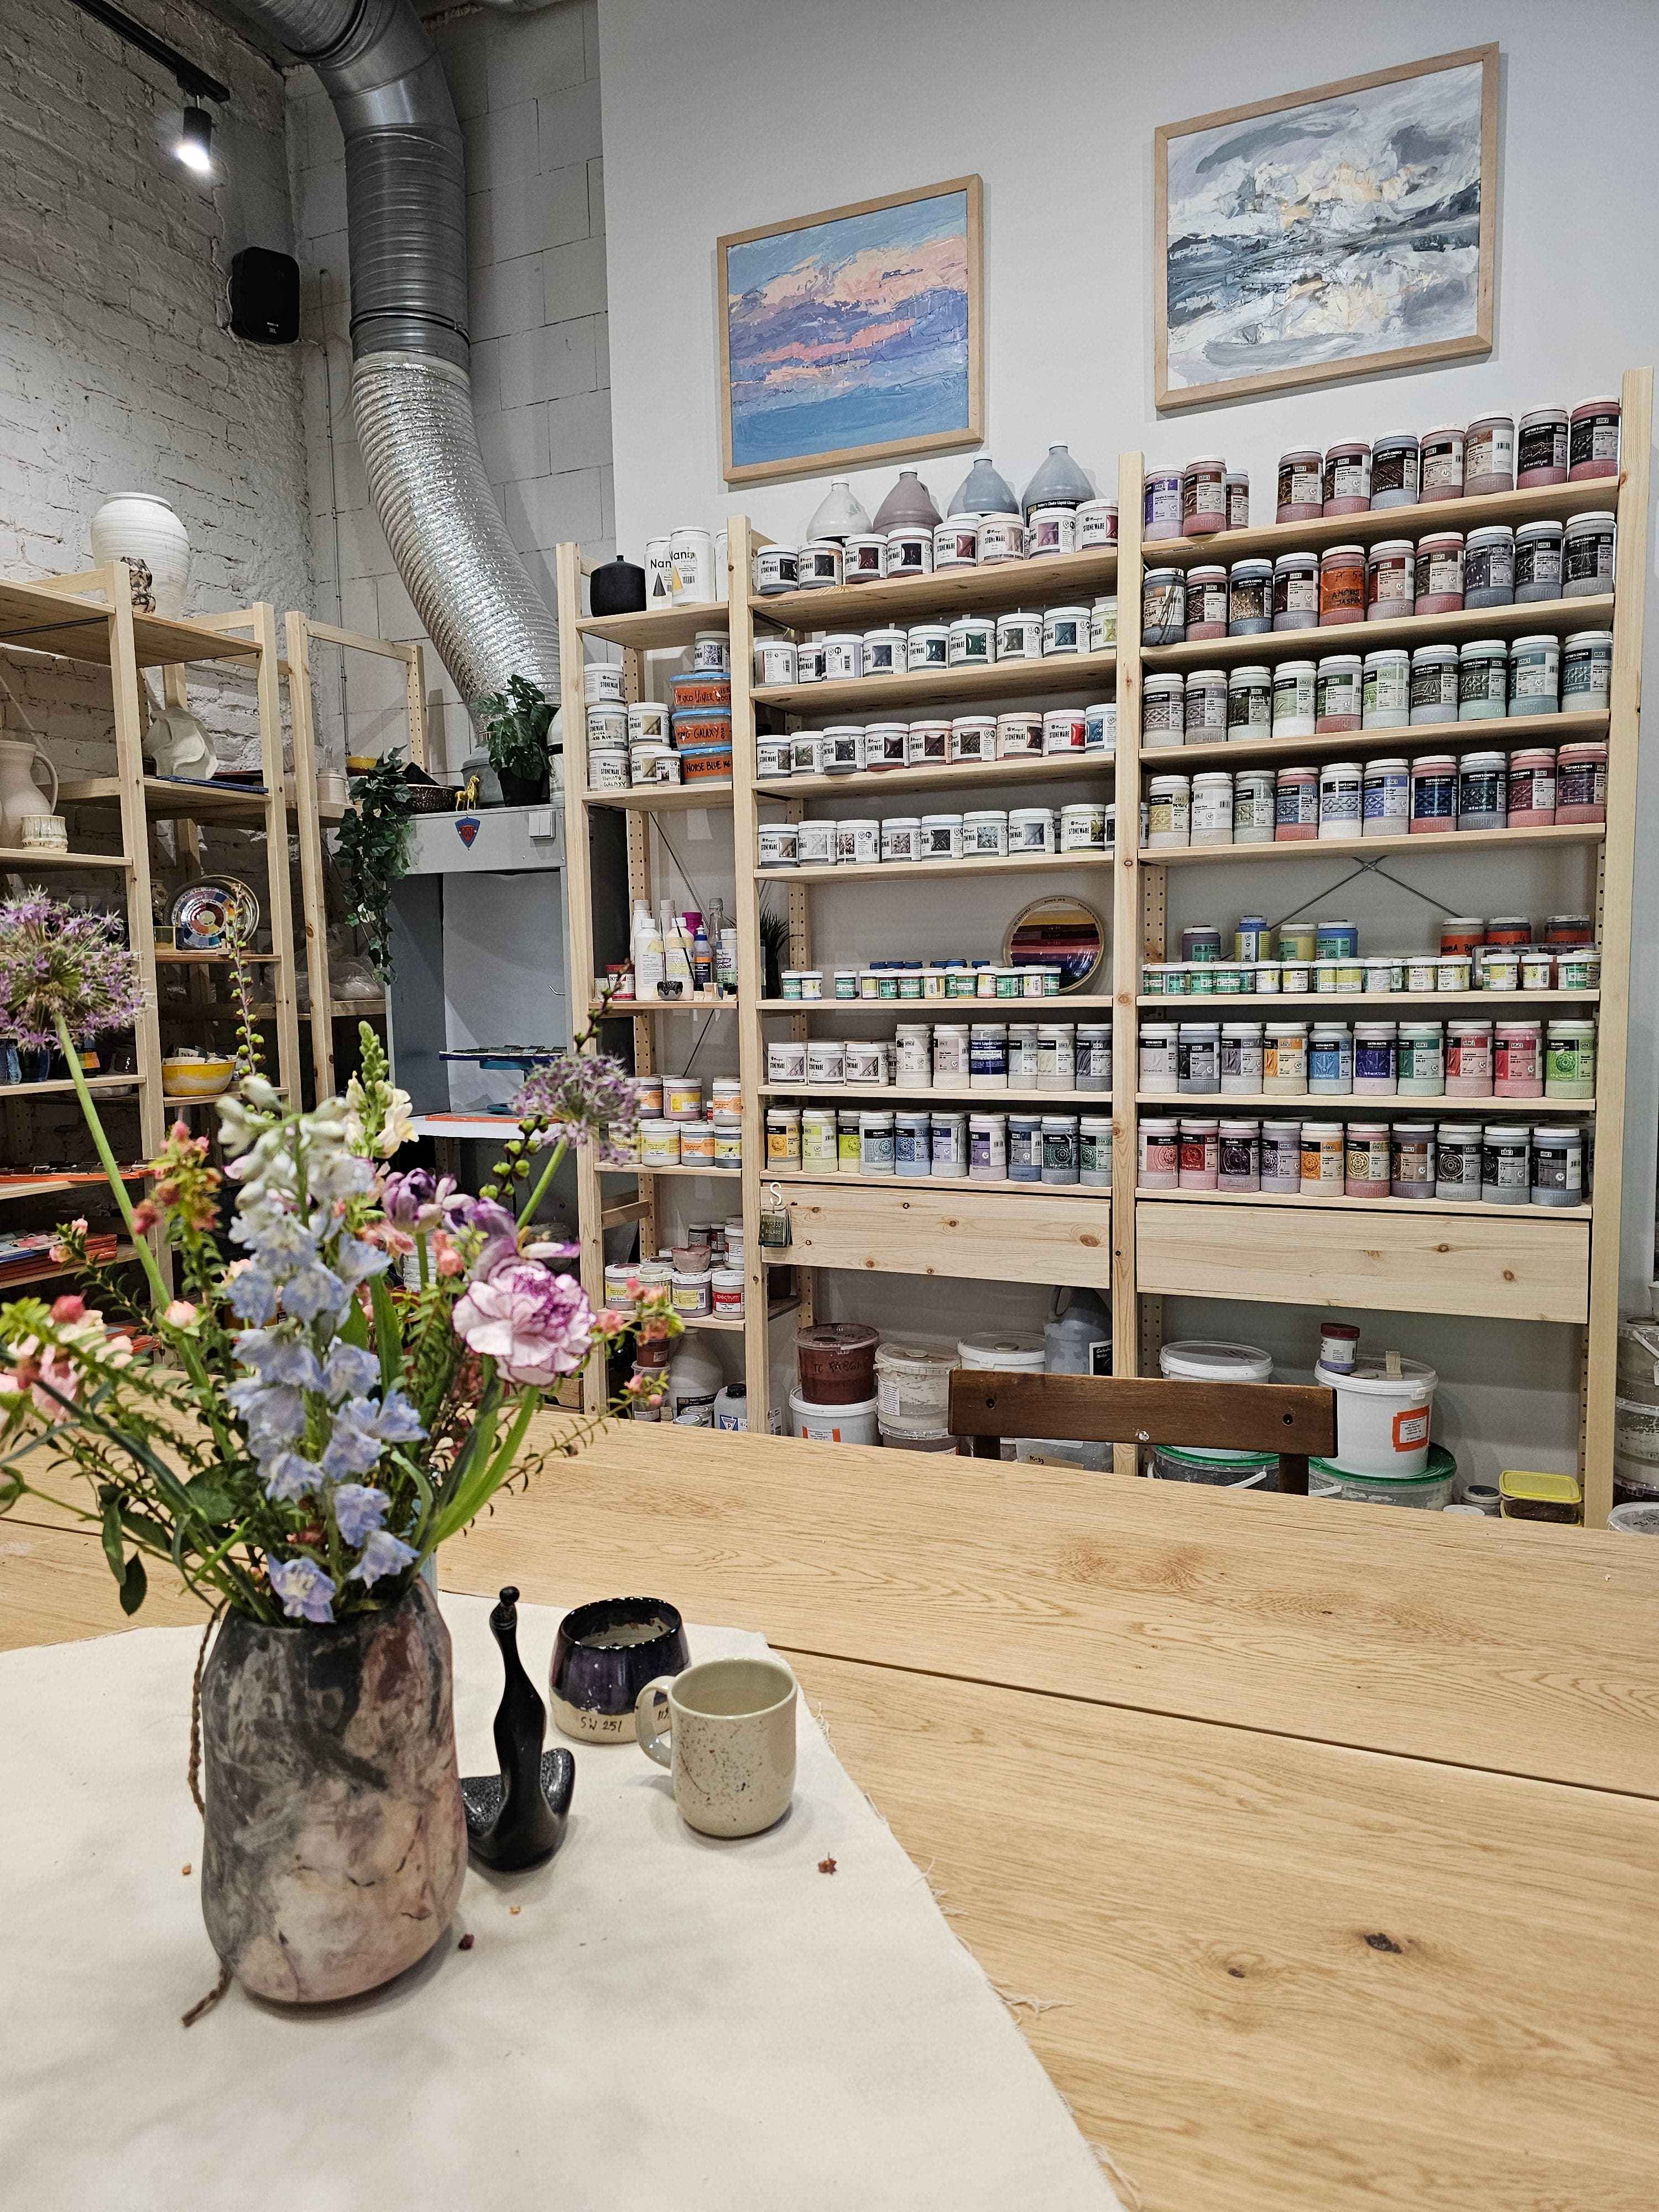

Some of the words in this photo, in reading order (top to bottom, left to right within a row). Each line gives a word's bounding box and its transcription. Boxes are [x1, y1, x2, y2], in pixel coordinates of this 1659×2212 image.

[1083, 522, 1105, 531] STONEWARE
[984, 535, 1006, 544] STONEWARE
[937, 543, 955, 552] STONEWARE
[651, 559, 671, 568] Nan
[707, 761, 721, 770] BLUE
[602, 1720, 622, 1733] 251
